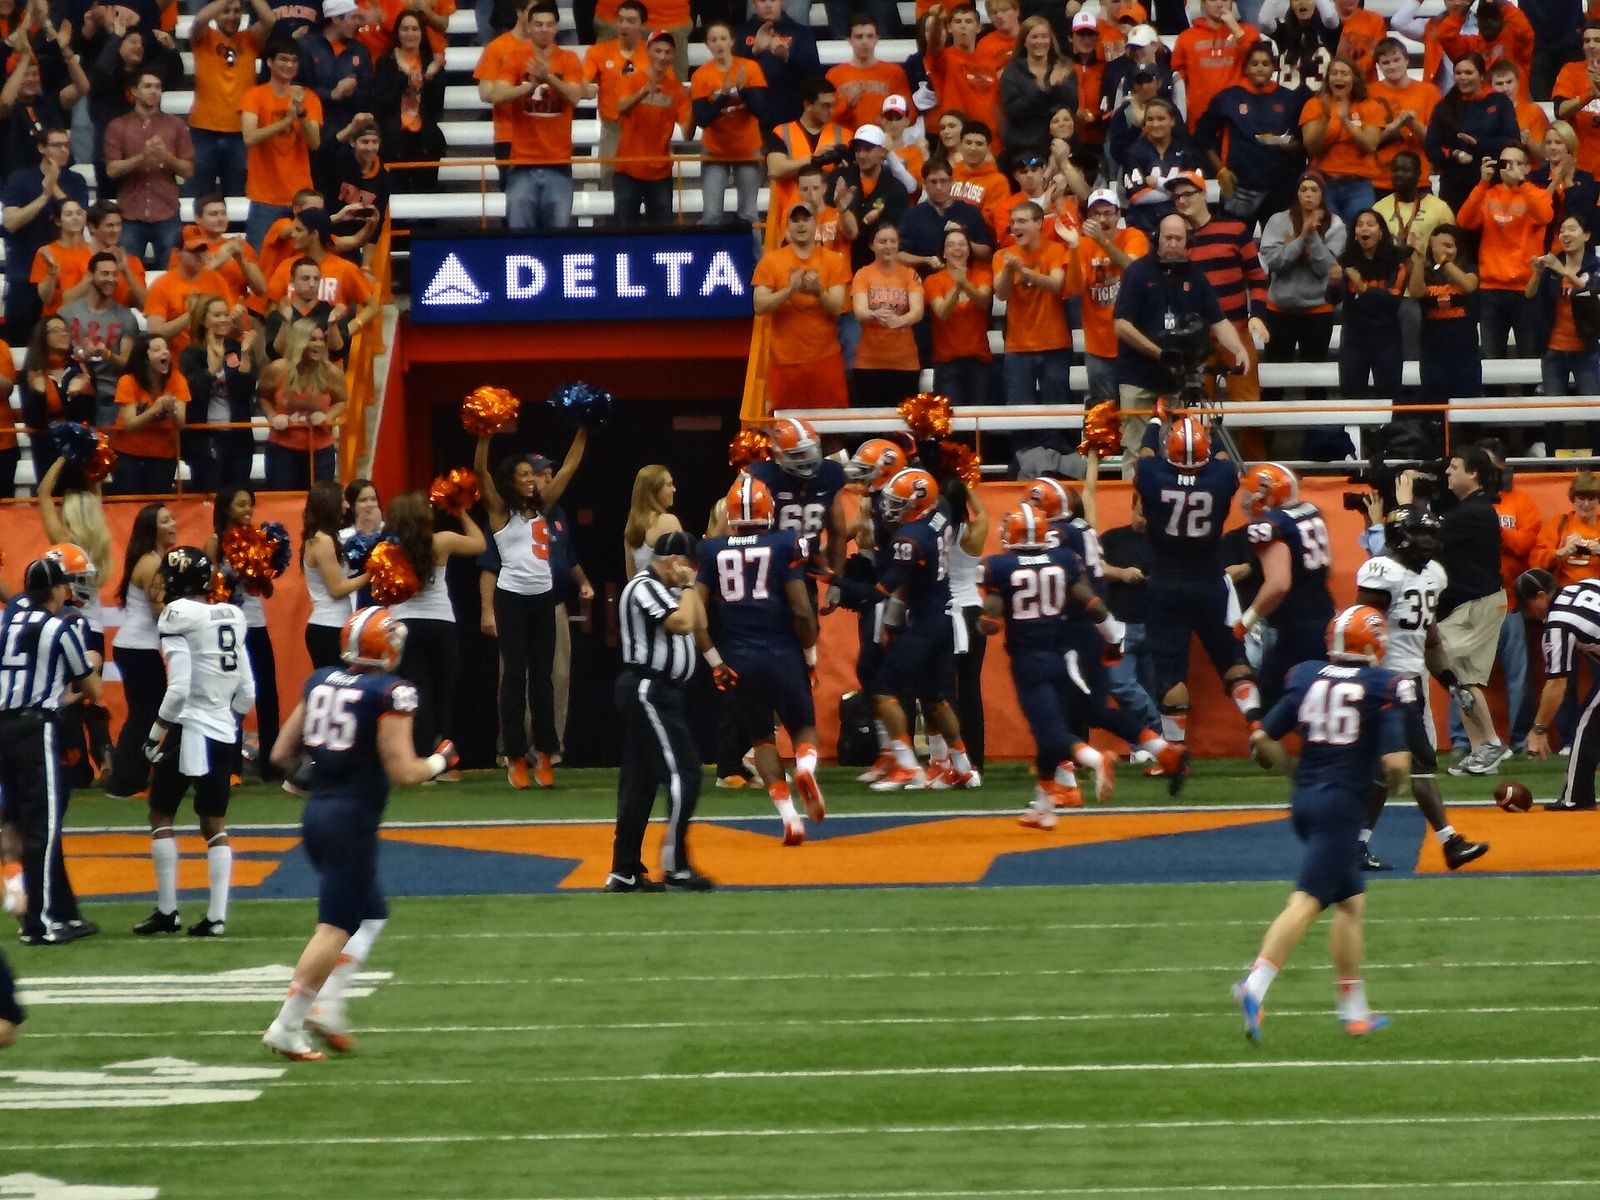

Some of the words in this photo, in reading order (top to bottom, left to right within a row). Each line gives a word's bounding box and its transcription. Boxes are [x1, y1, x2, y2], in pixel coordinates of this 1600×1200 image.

[505, 251, 745, 300] DELTA
[779, 503, 826, 540] 68
[1160, 489, 1213, 538] 72
[530, 518, 550, 561] S
[716, 546, 771, 602] 87
[1010, 565, 1066, 620] 20
[2, 623, 28, 667] L
[218, 624, 238, 672] 9
[303, 684, 365, 751] 85
[1297, 680, 1366, 745] 46
